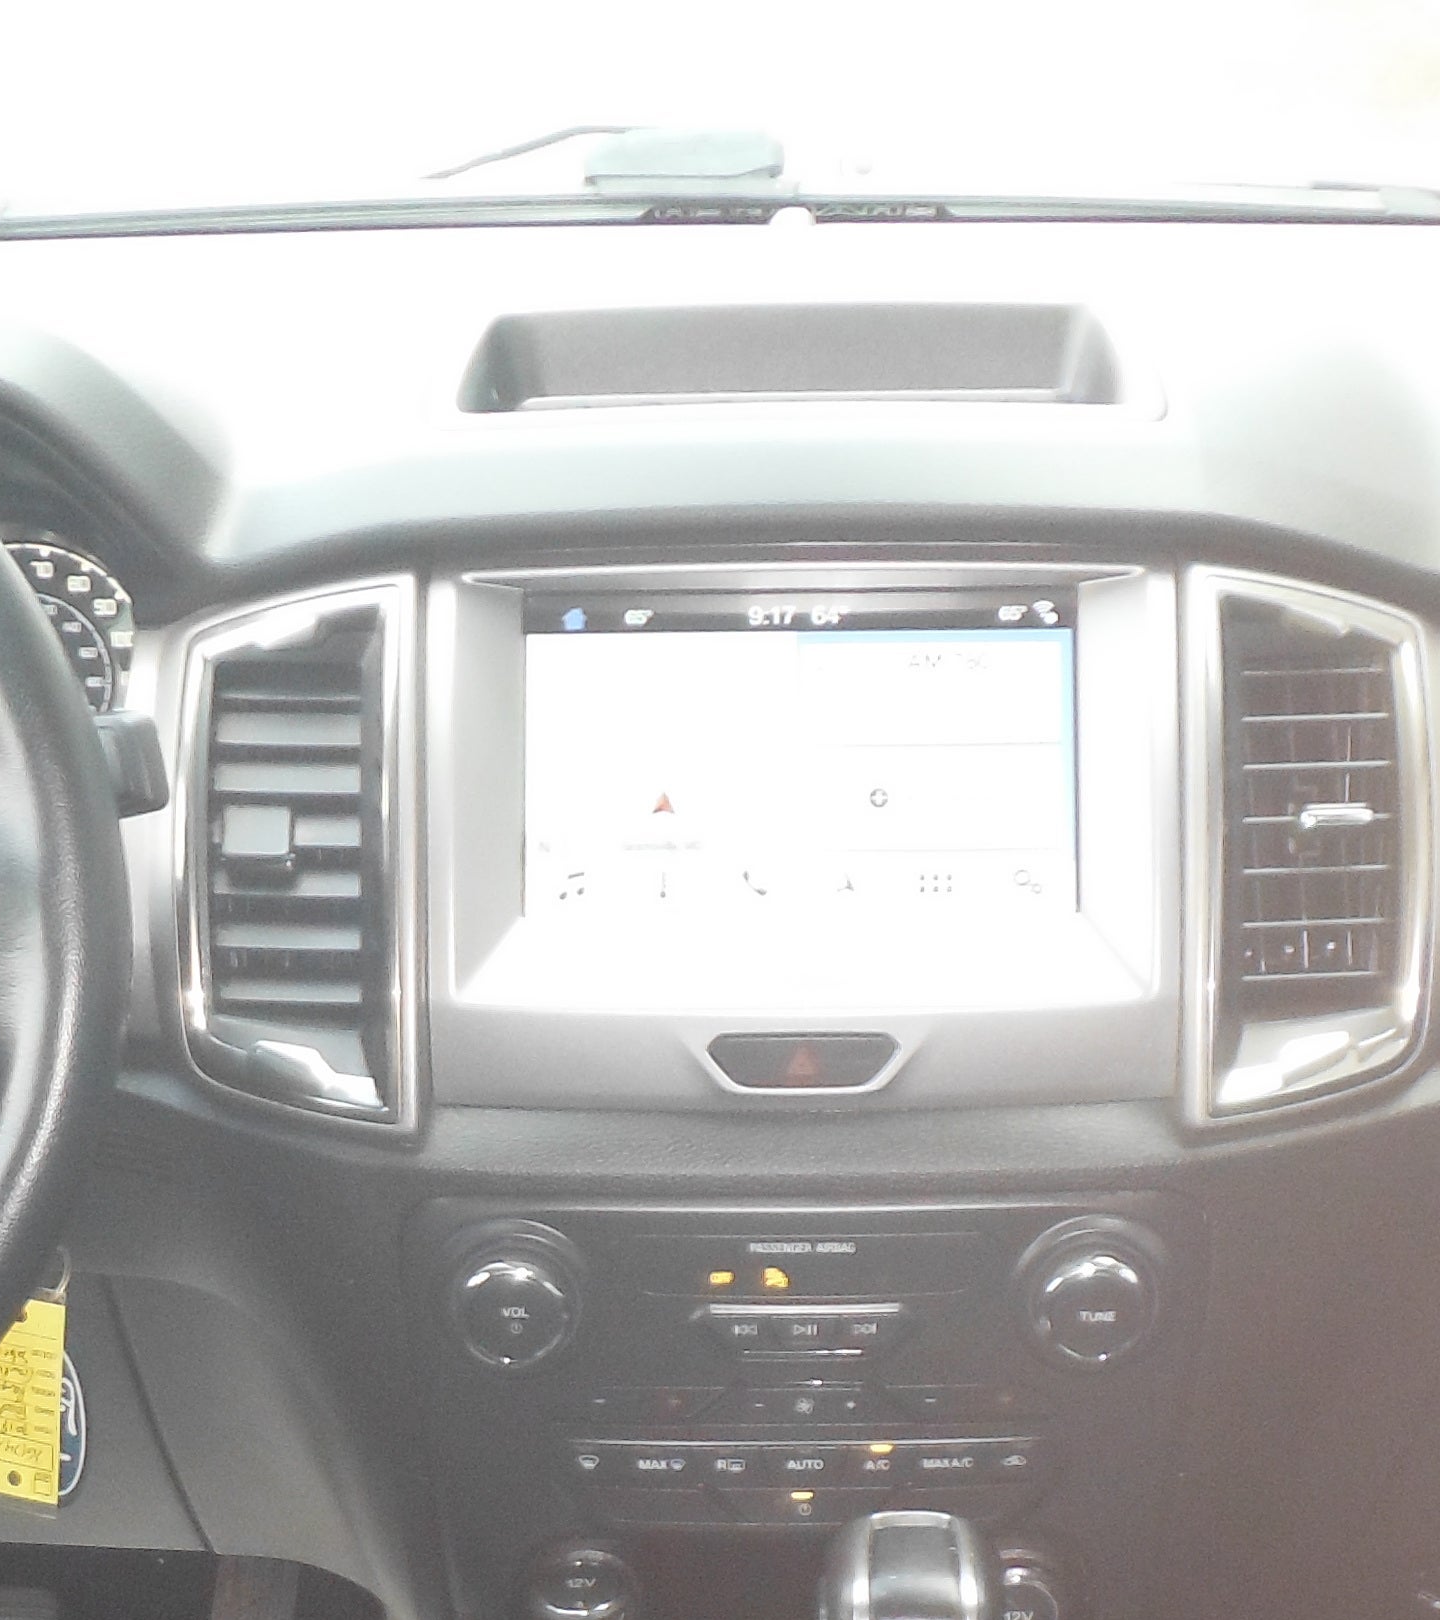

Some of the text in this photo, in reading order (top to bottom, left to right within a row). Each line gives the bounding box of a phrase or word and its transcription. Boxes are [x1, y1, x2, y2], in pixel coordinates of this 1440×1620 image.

[30, 561, 53, 578] 70
[747, 605, 796, 625] 9:17
[750, 1242, 857, 1253] PASSENGER AIRBAG
[502, 1306, 530, 1318] VOL
[1080, 1310, 1117, 1322] TUNE
[638, 1458, 667, 1470] MAX
[787, 1458, 825, 1471] AUTO
[865, 1459, 891, 1471] A/C
